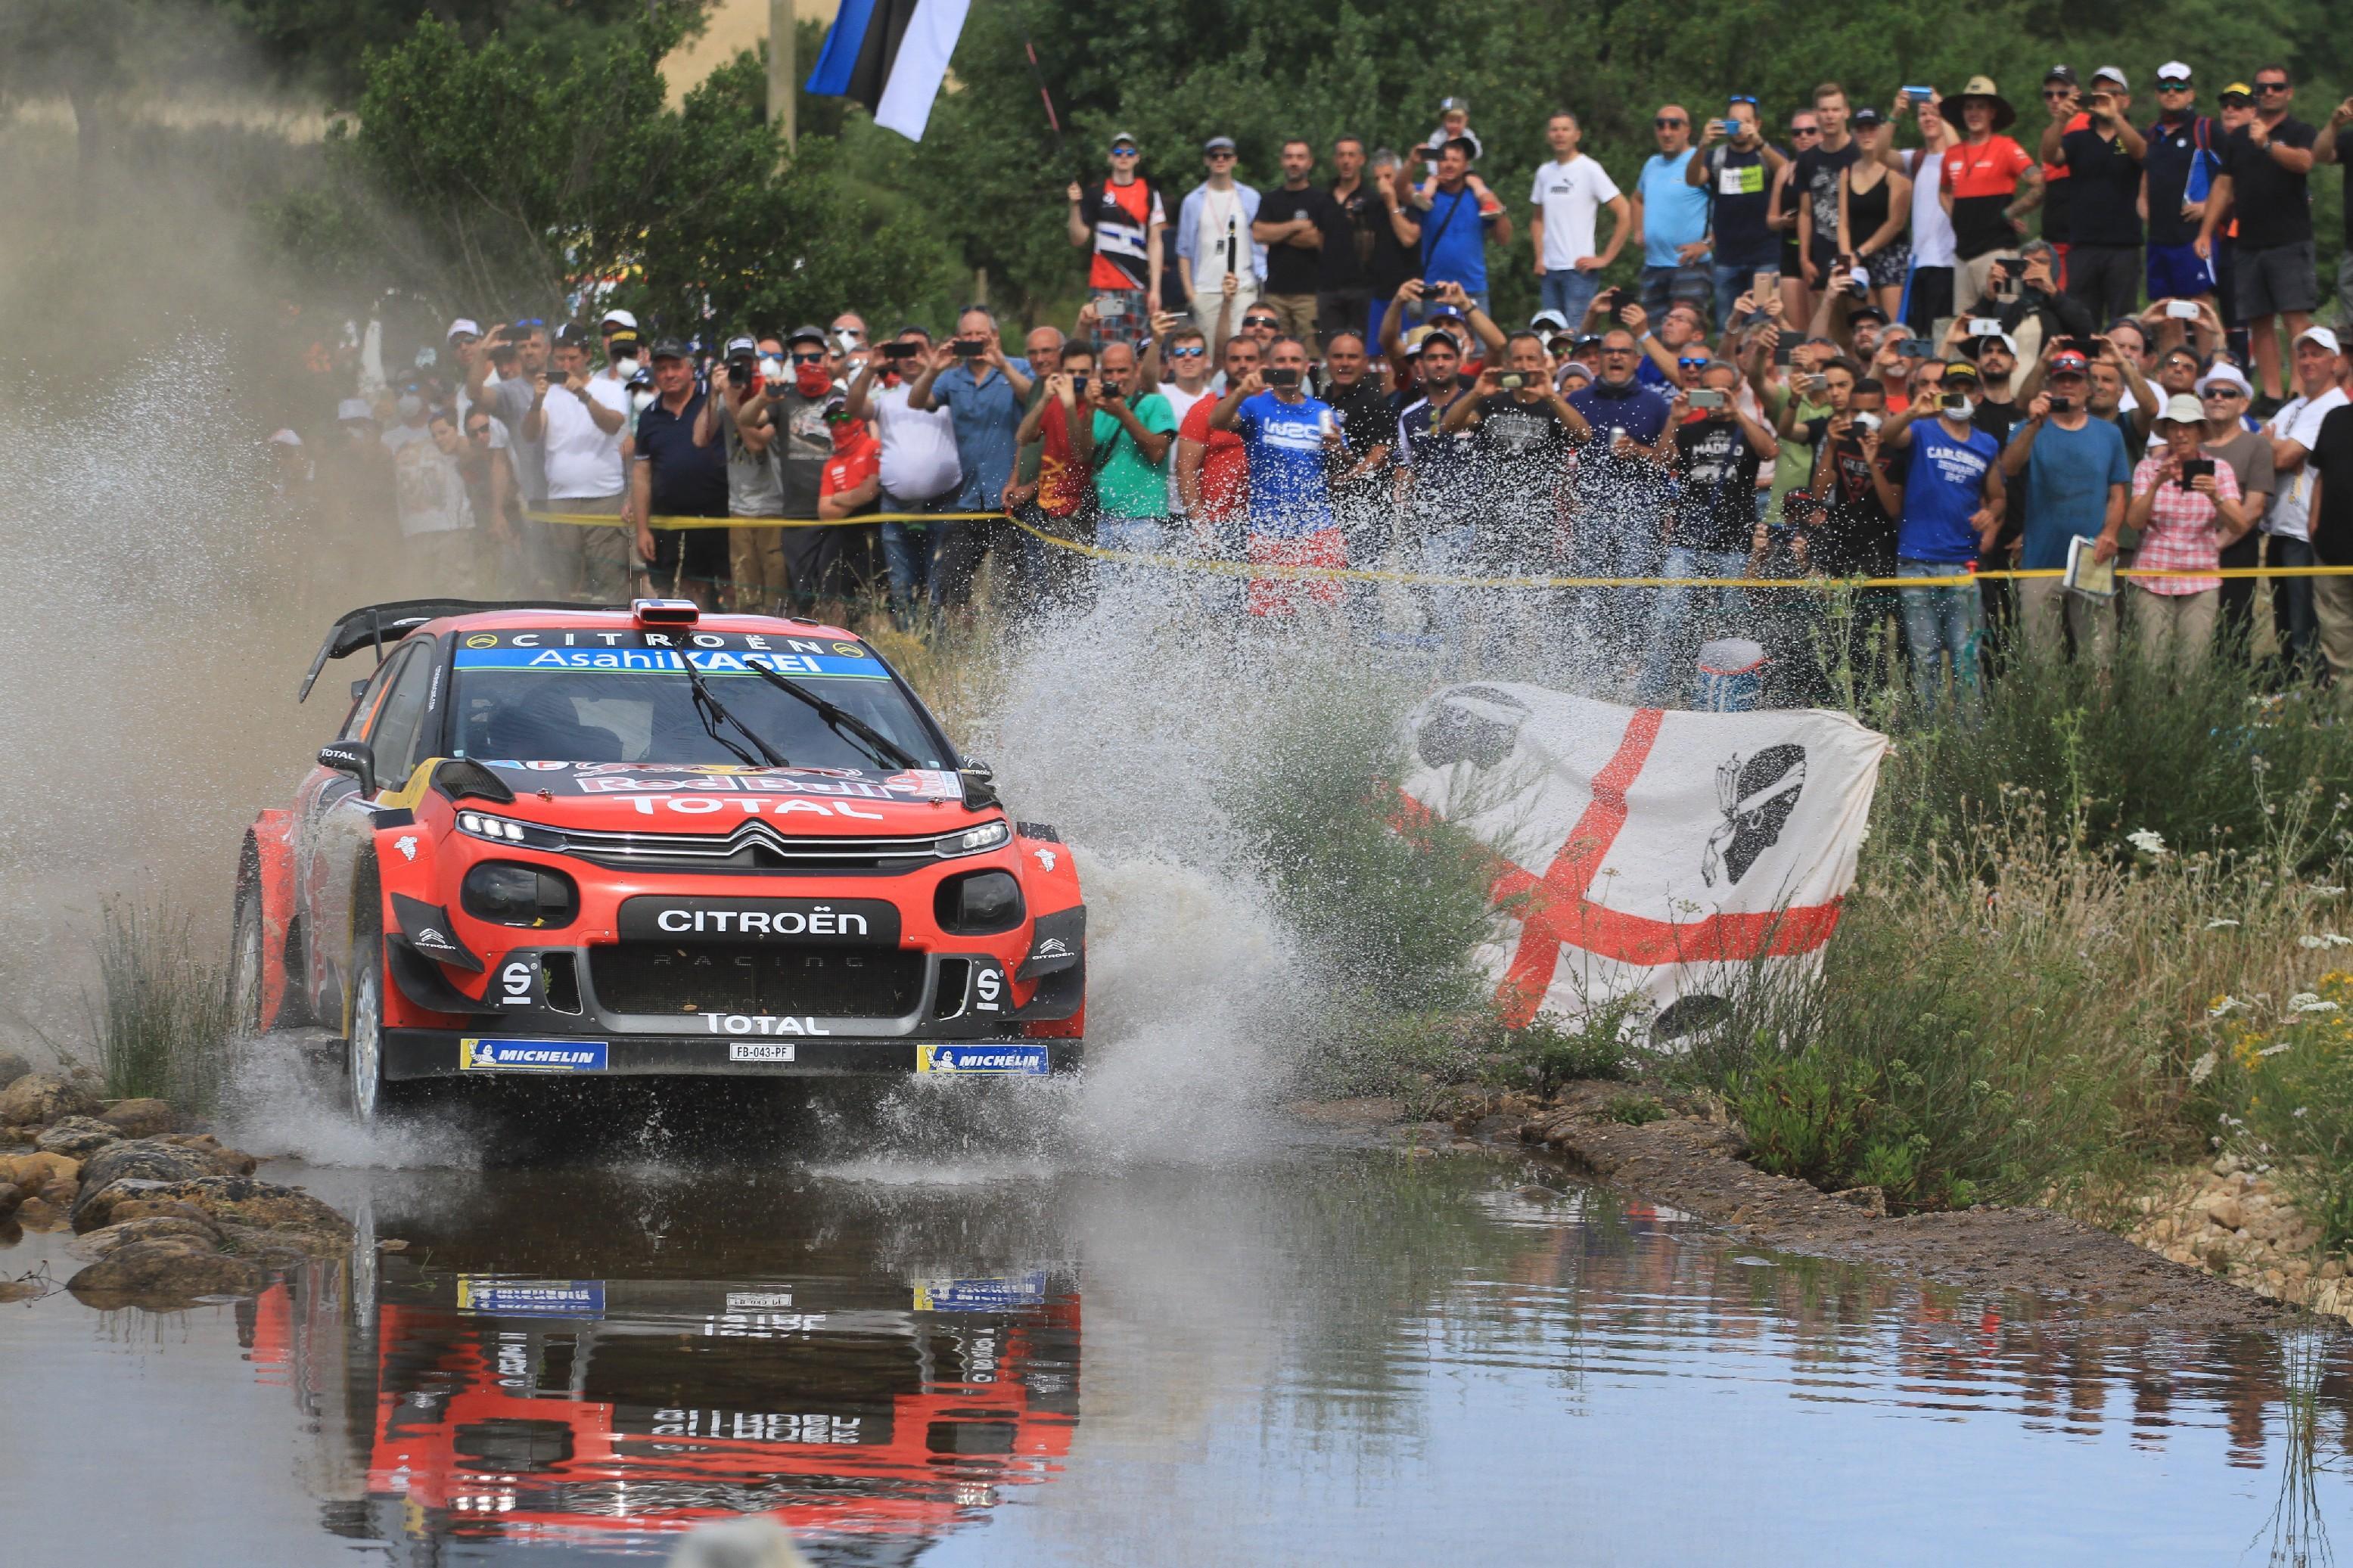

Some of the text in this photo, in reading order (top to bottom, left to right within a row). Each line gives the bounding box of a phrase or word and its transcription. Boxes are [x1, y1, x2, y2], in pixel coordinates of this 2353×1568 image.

[1692, 444, 1744, 456] MADRD
[320, 748, 356, 761] TOTAL
[576, 775, 739, 793] Red
[738, 776, 894, 800] Bull
[614, 796, 884, 820] TOTAL
[698, 1013, 830, 1036] TOTAL
[498, 1049, 595, 1064] MICHELIN
[737, 1047, 788, 1058] FB-043-PF
[959, 1055, 1040, 1067] MICHELIN
